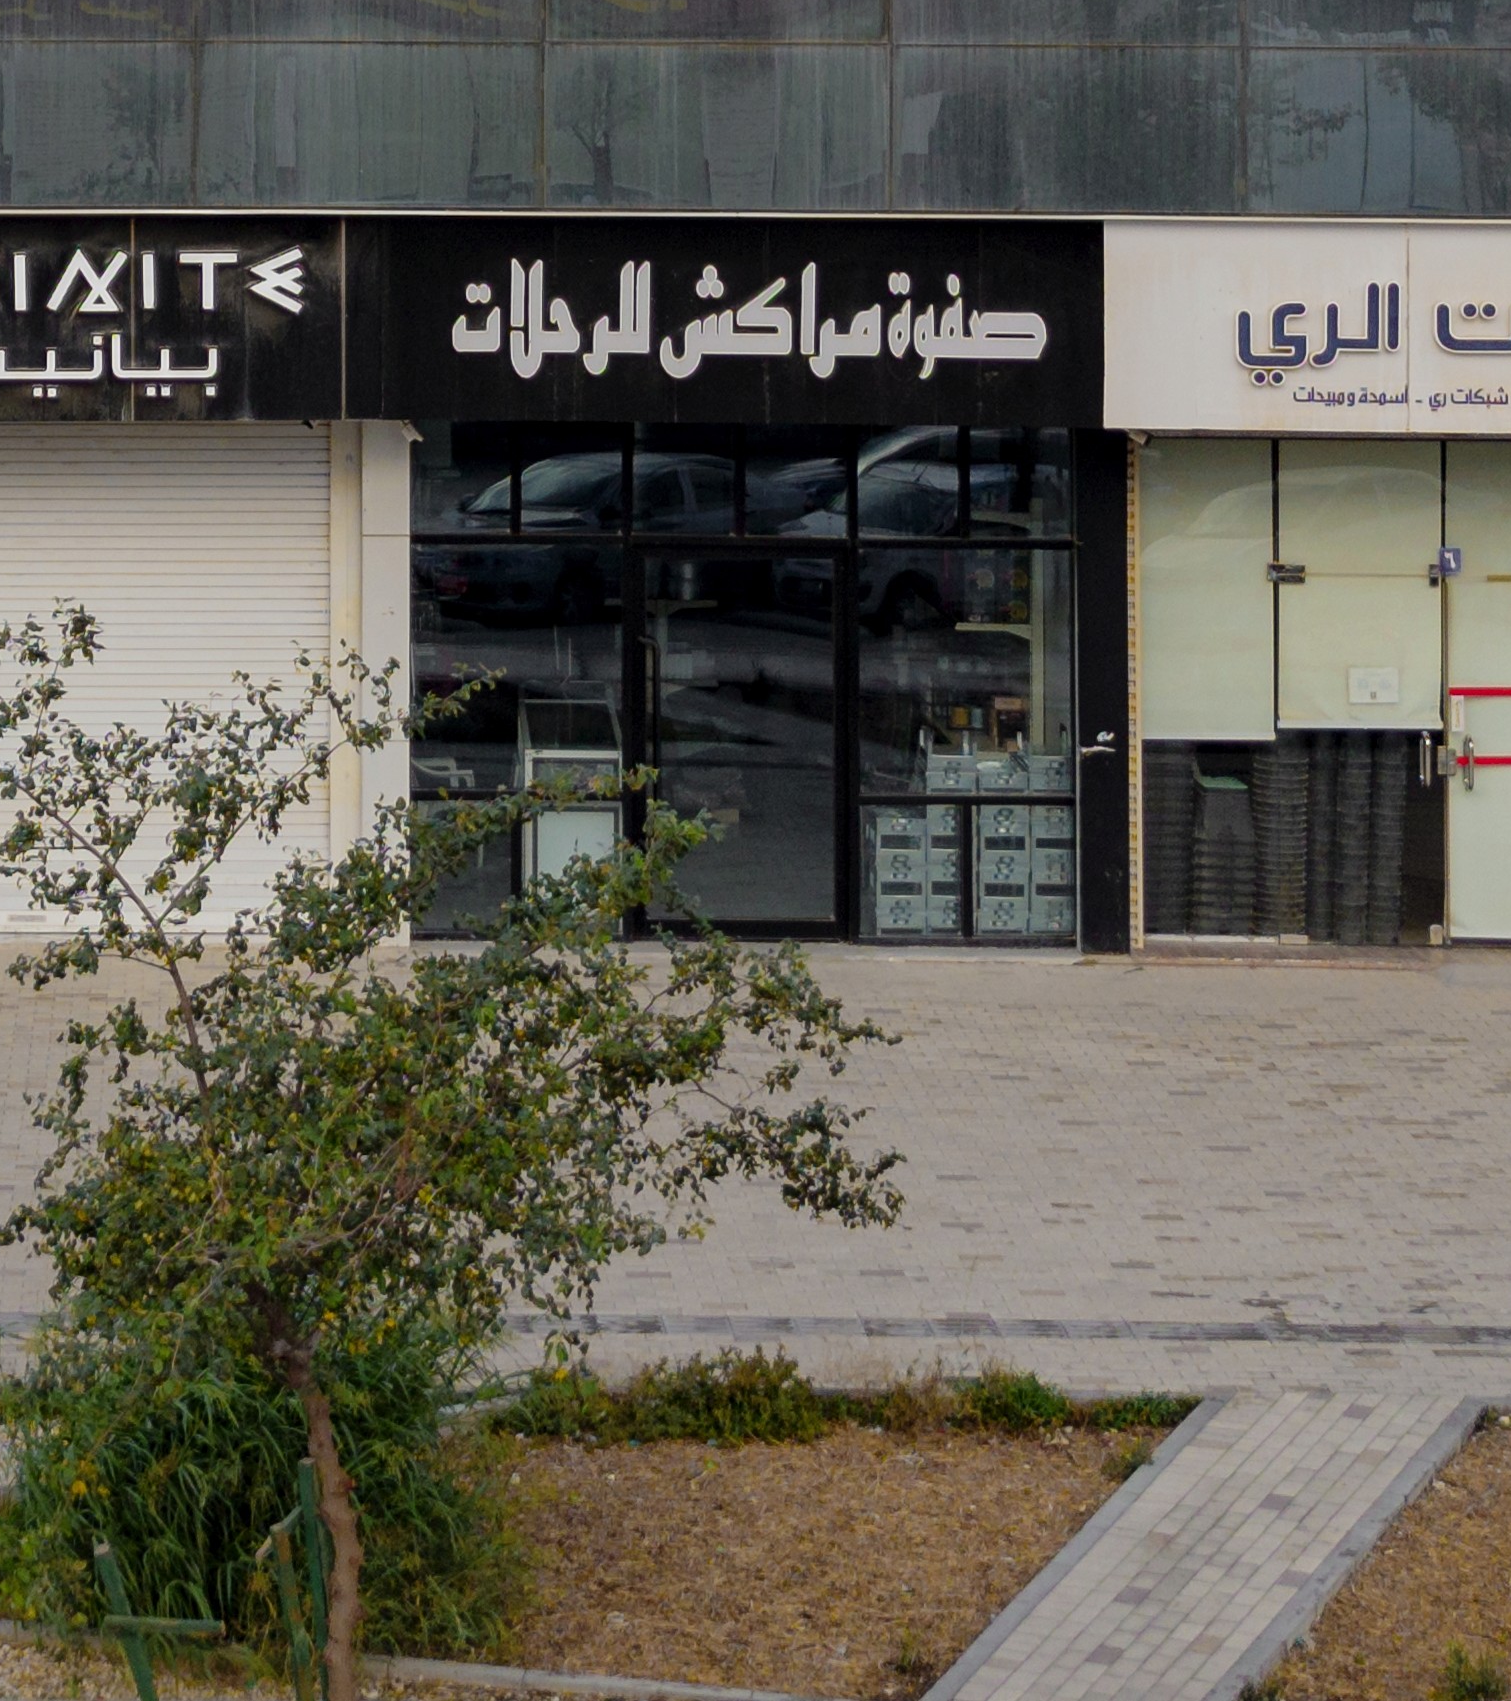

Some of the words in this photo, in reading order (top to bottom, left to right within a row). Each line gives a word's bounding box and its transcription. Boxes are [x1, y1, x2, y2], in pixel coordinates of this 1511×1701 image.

[451, 257, 652, 379] للرحلات
[659, 260, 883, 380] مراكش
[886, 271, 1048, 380] صفوة
[1233, 279, 1402, 387] الري
[1428, 392, 1447, 412] ري
[1450, 386, 1509, 410] شبكات
